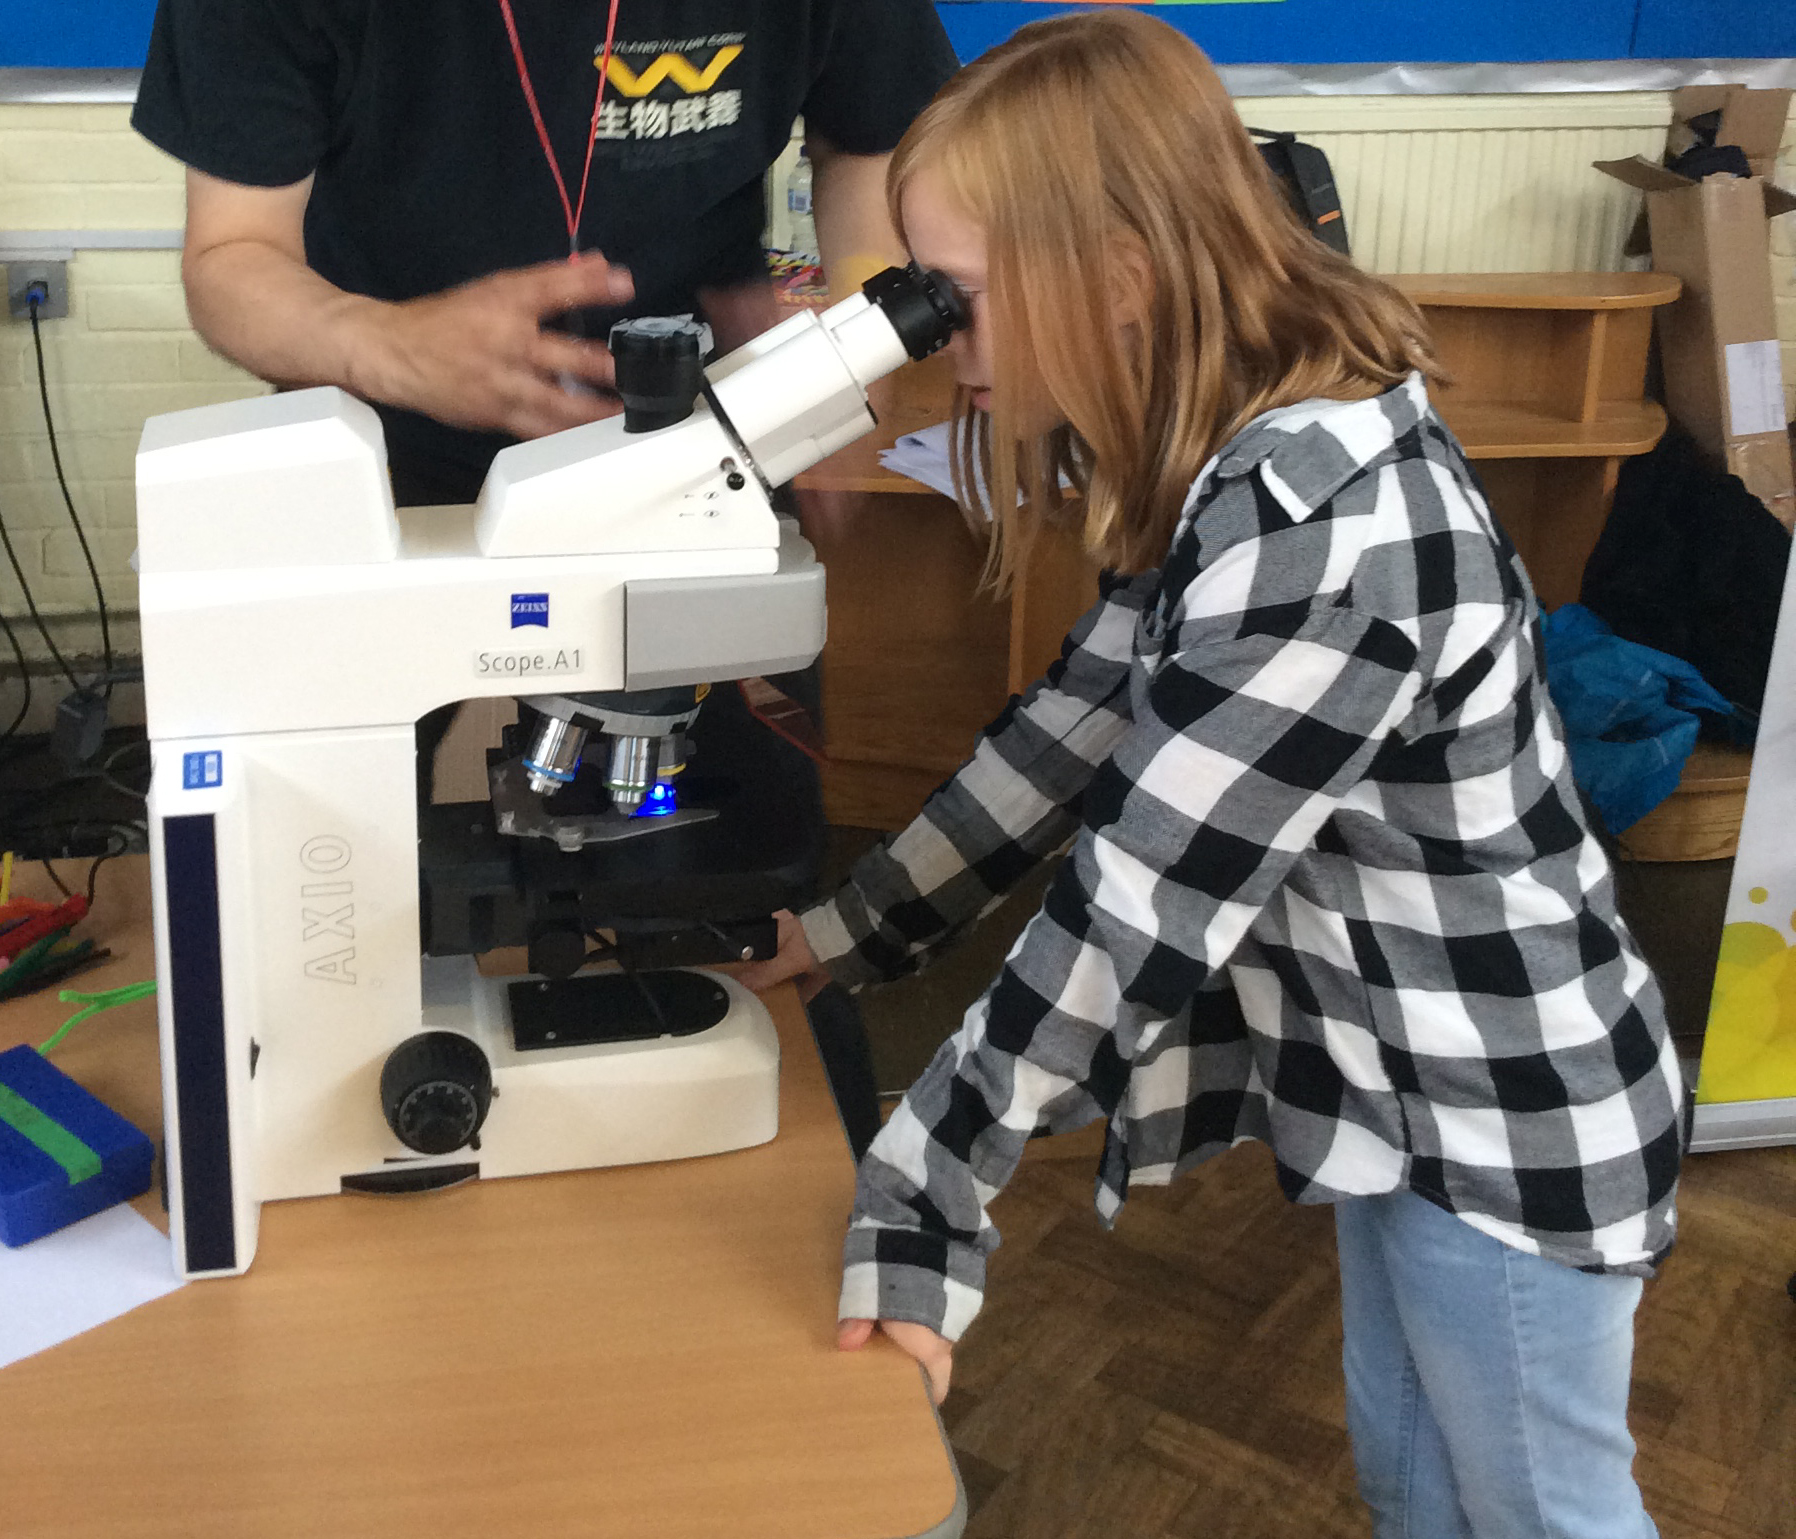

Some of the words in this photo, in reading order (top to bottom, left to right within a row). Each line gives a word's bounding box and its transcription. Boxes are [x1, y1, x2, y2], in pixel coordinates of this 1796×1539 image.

[511, 602, 548, 613] ZEISS
[479, 649, 580, 676] Scope.A1
[300, 834, 356, 985] AXIO
